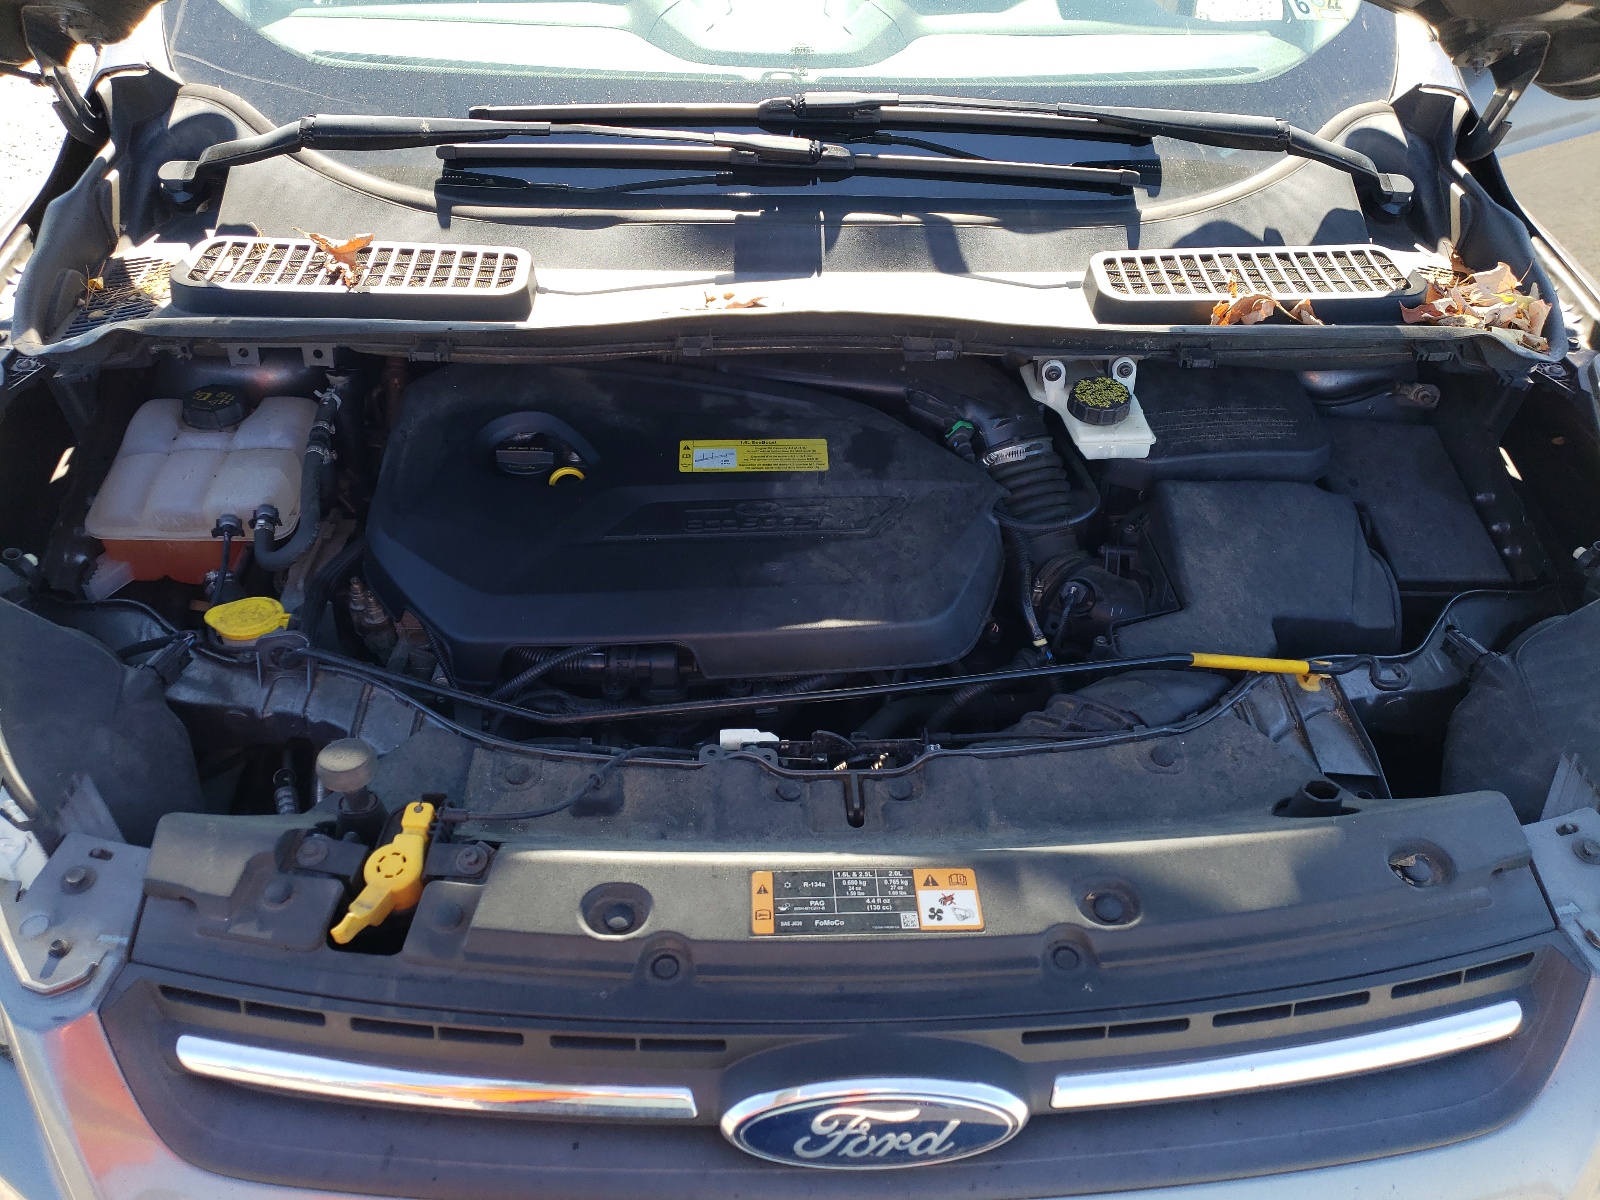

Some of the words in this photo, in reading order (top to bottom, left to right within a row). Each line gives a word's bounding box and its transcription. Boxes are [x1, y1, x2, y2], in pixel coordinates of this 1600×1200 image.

[858, 879, 867, 887] kg
[814, 919, 845, 927] FoMoCo
[793, 1106, 961, 1158] Ford
